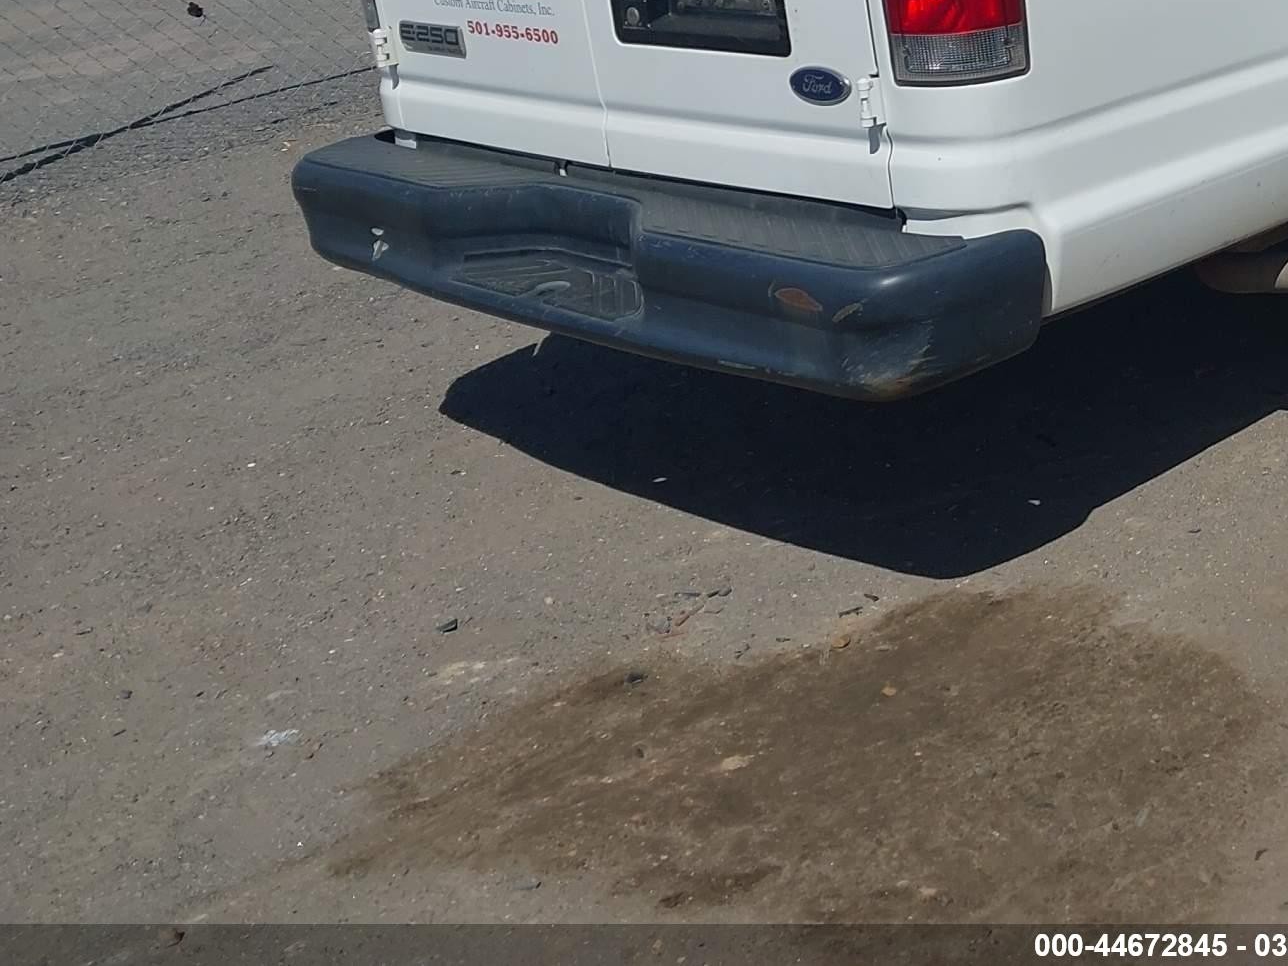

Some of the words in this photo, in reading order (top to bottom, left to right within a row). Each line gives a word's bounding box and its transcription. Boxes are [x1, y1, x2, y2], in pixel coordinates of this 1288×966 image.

[496, 0, 537, 15] Cabinets,
[537, 2, 556, 17] Inc.
[466, 20, 560, 44] 501-955-6500
[802, 74, 833, 94] Ford
